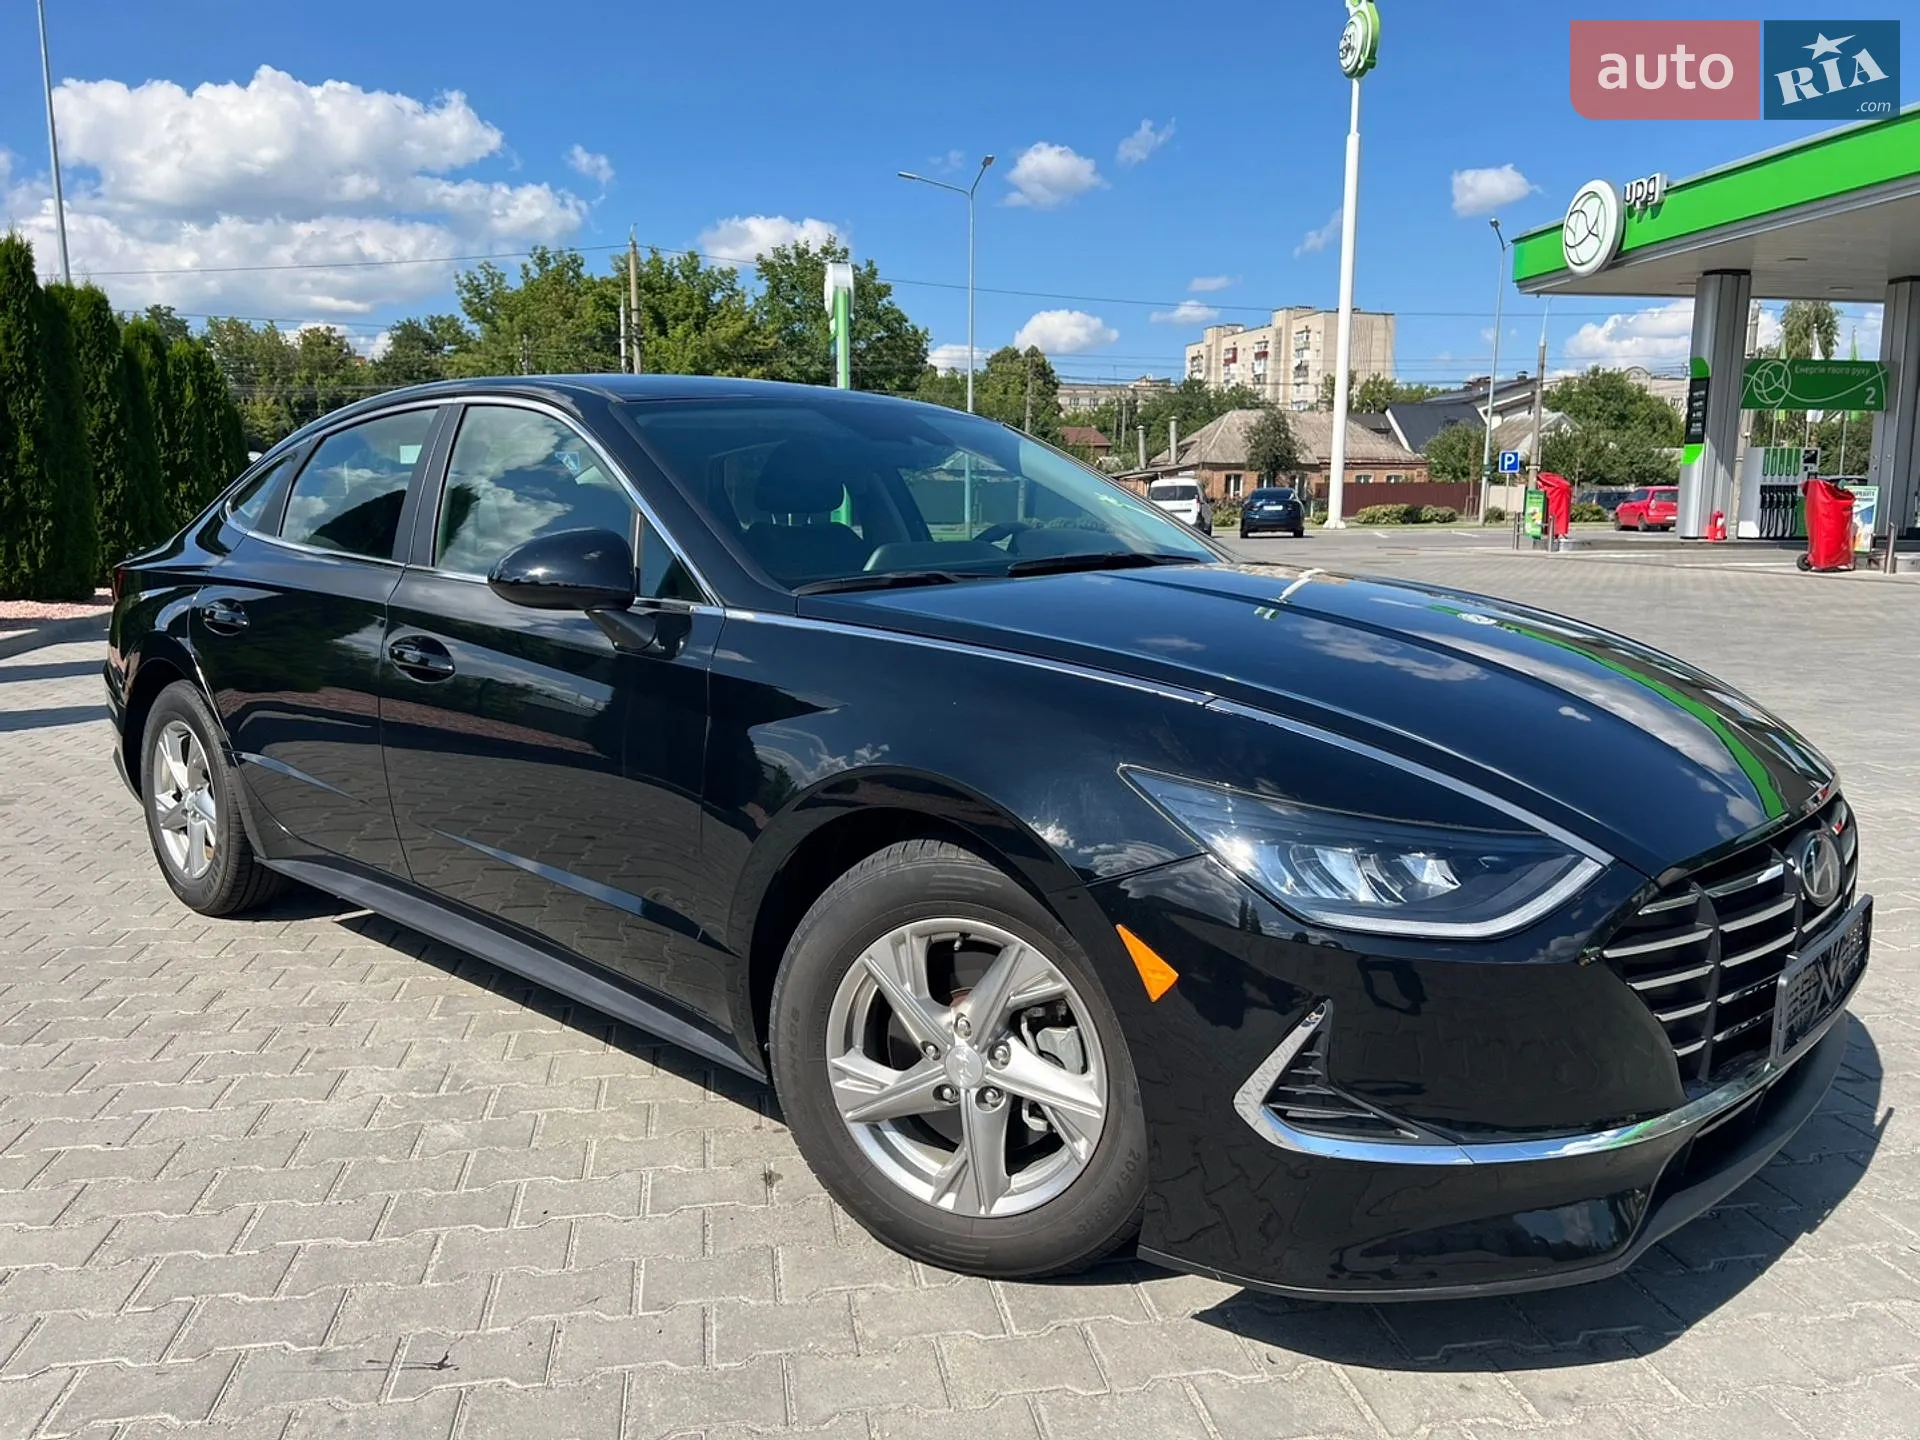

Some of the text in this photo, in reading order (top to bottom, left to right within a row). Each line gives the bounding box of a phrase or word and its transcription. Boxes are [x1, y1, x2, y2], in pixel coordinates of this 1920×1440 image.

[1624, 174, 1659, 208] upg
[1864, 386, 1876, 405] 2
[1504, 453, 1516, 471] P
